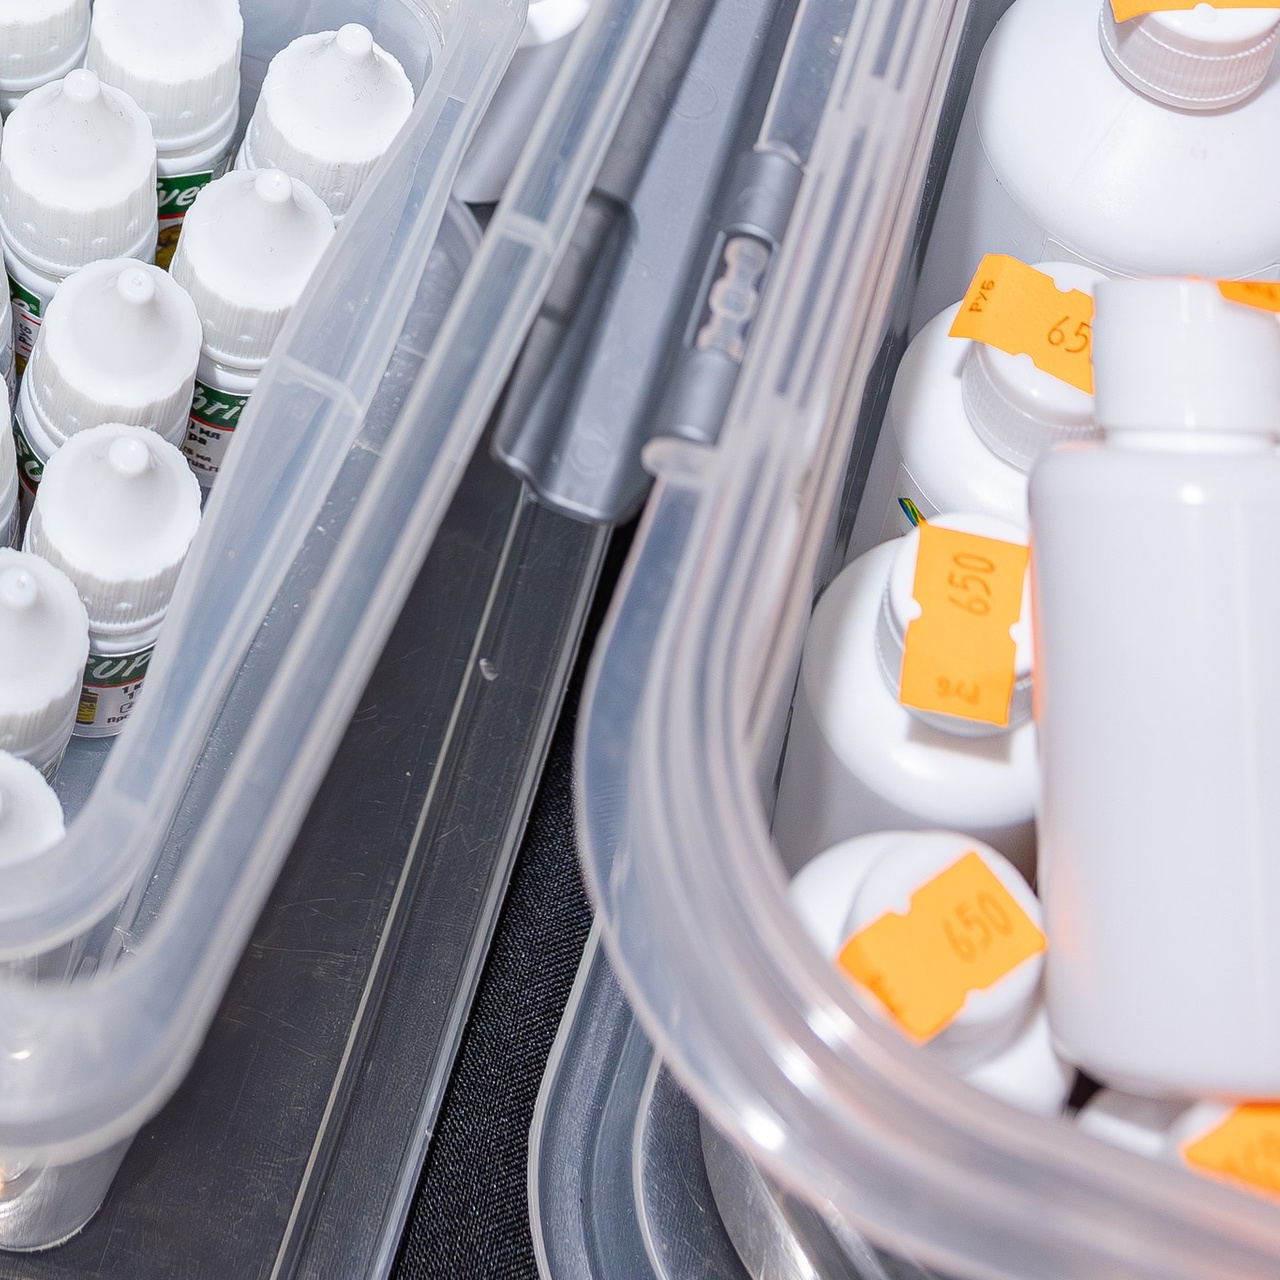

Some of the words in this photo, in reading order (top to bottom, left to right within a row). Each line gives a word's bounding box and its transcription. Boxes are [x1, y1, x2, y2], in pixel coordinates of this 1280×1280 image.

[968, 278, 995, 313] РУБ
[1047, 315, 1092, 354] 65
[947, 552, 996, 617] 650
[941, 889, 1014, 965] 650
